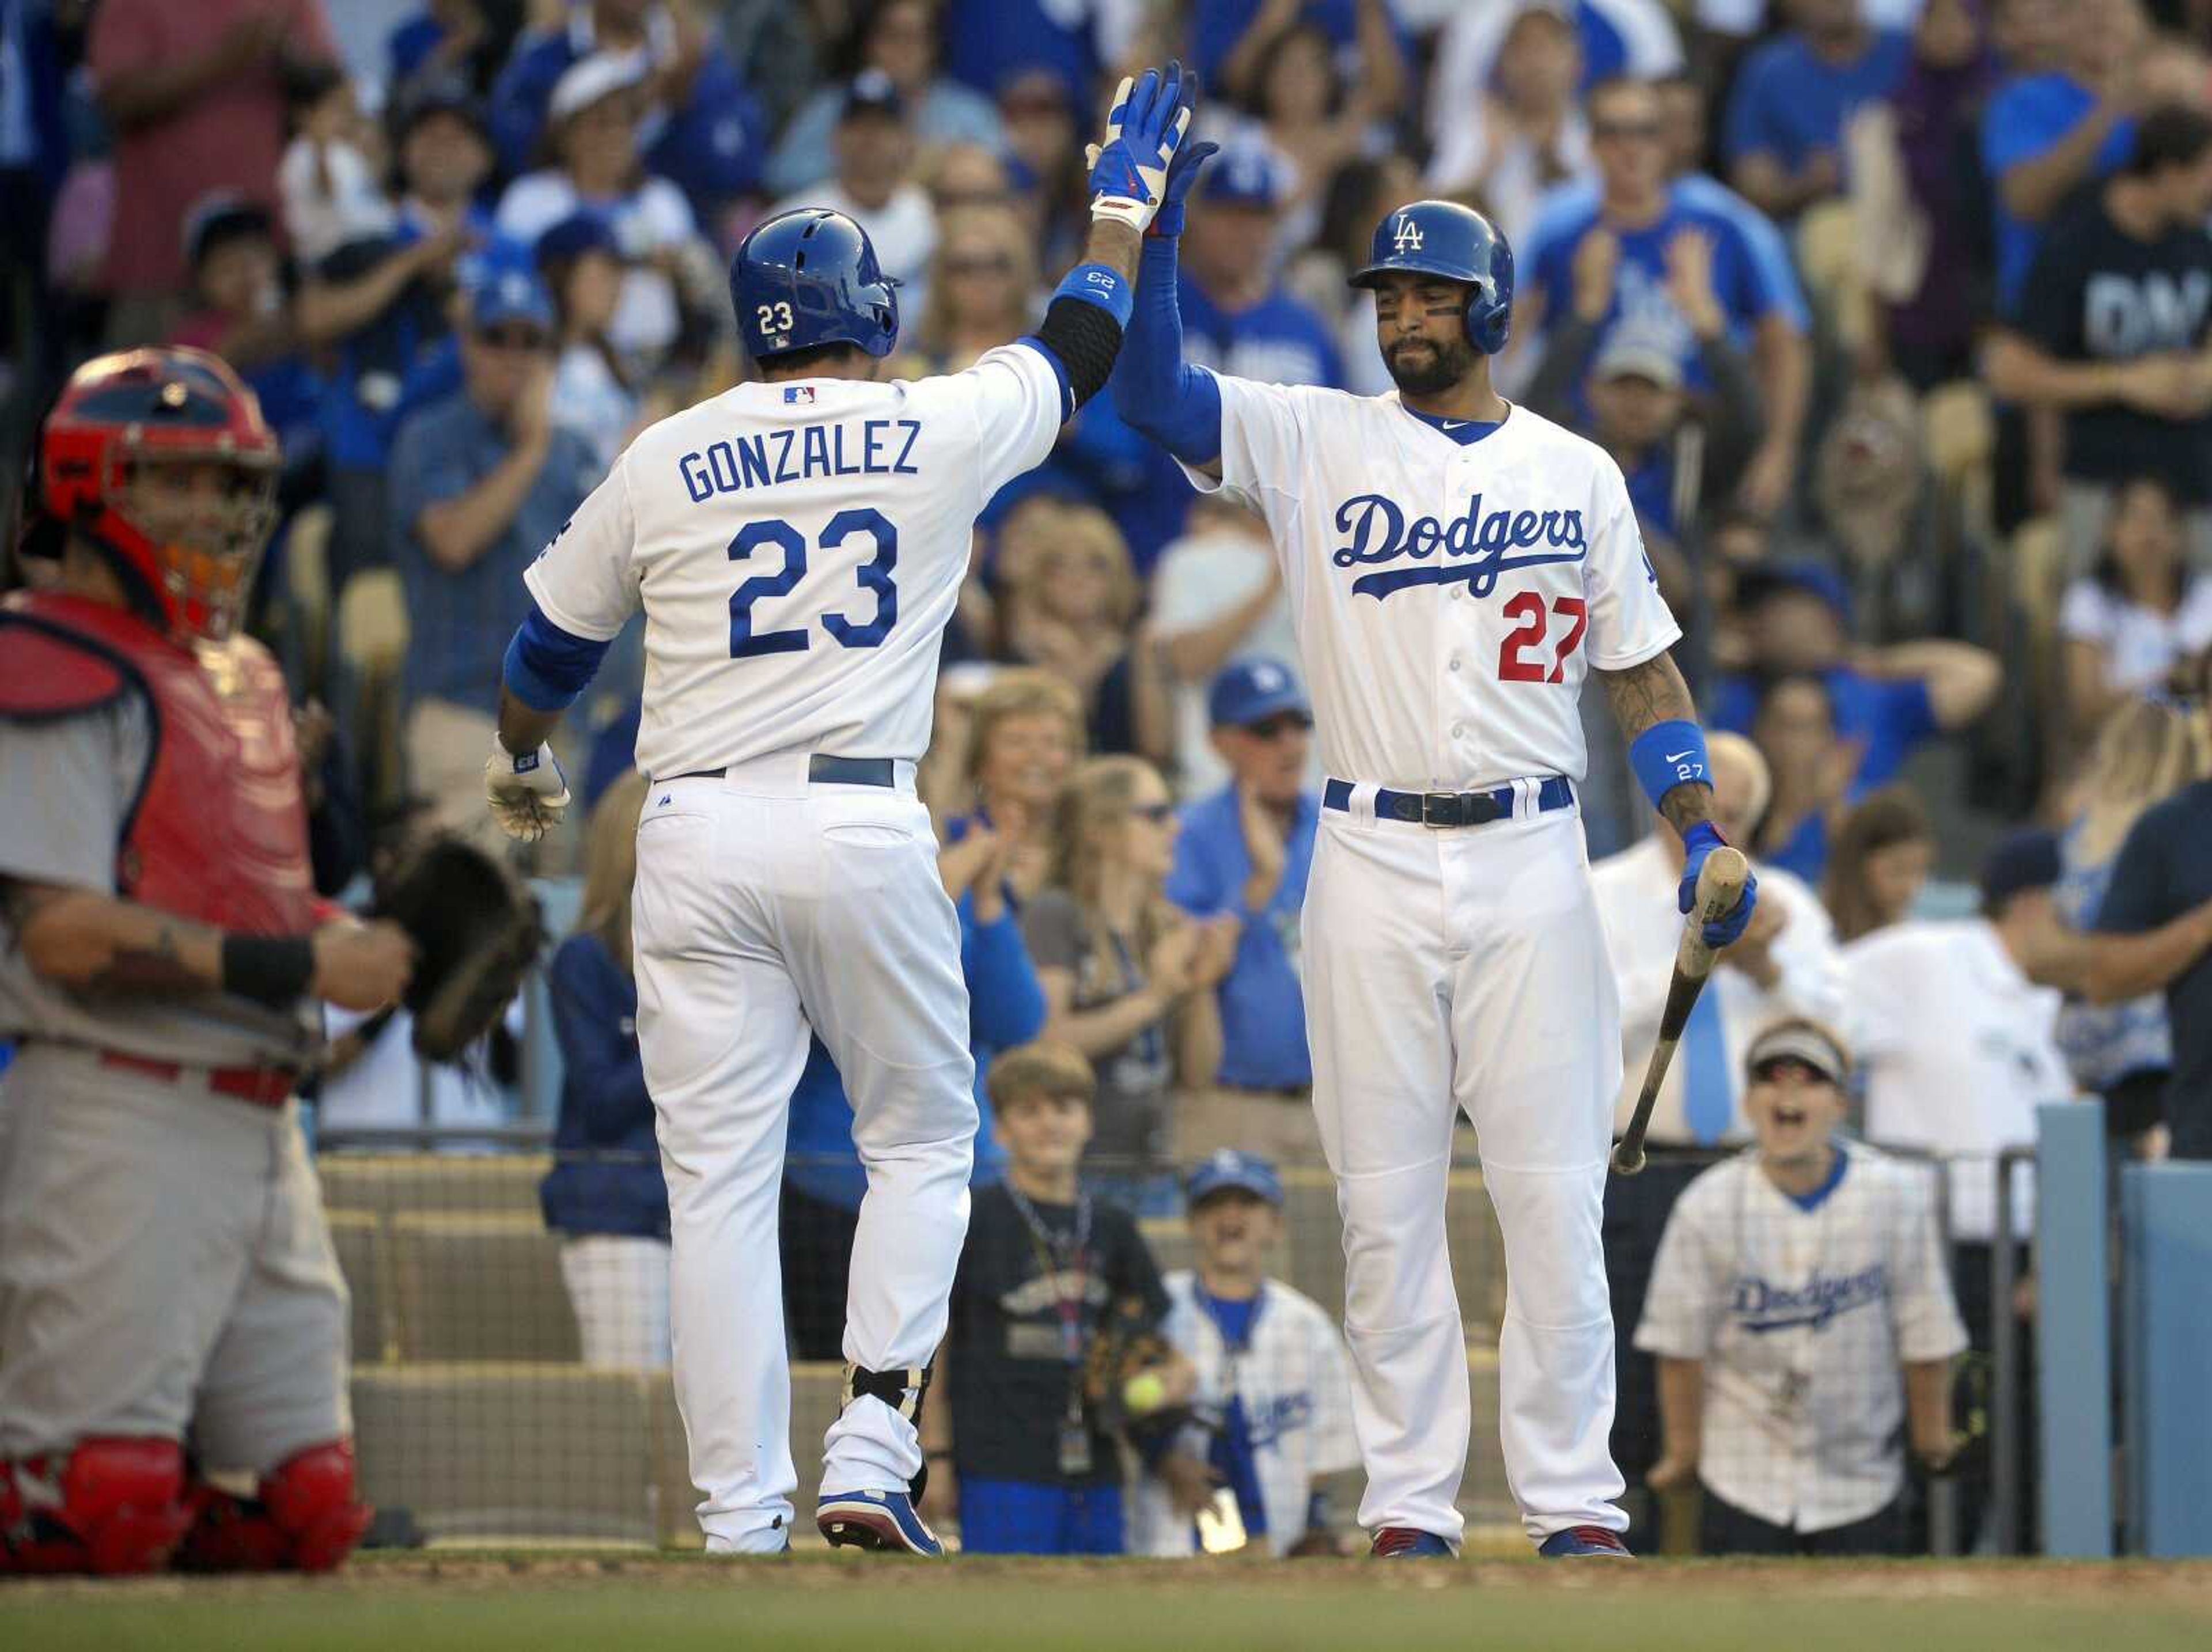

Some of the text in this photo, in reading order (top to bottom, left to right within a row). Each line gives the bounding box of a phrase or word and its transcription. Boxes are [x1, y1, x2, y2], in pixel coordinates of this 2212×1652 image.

[1393, 214, 1423, 255] LA
[1086, 272, 1115, 289] 23
[757, 301, 793, 335] 23
[680, 420, 921, 502] GONZALEZ
[1332, 493, 1587, 601] Dodgers
[728, 507, 898, 658] 23
[1498, 590, 1588, 684] 27
[1677, 764, 1703, 780] 27
